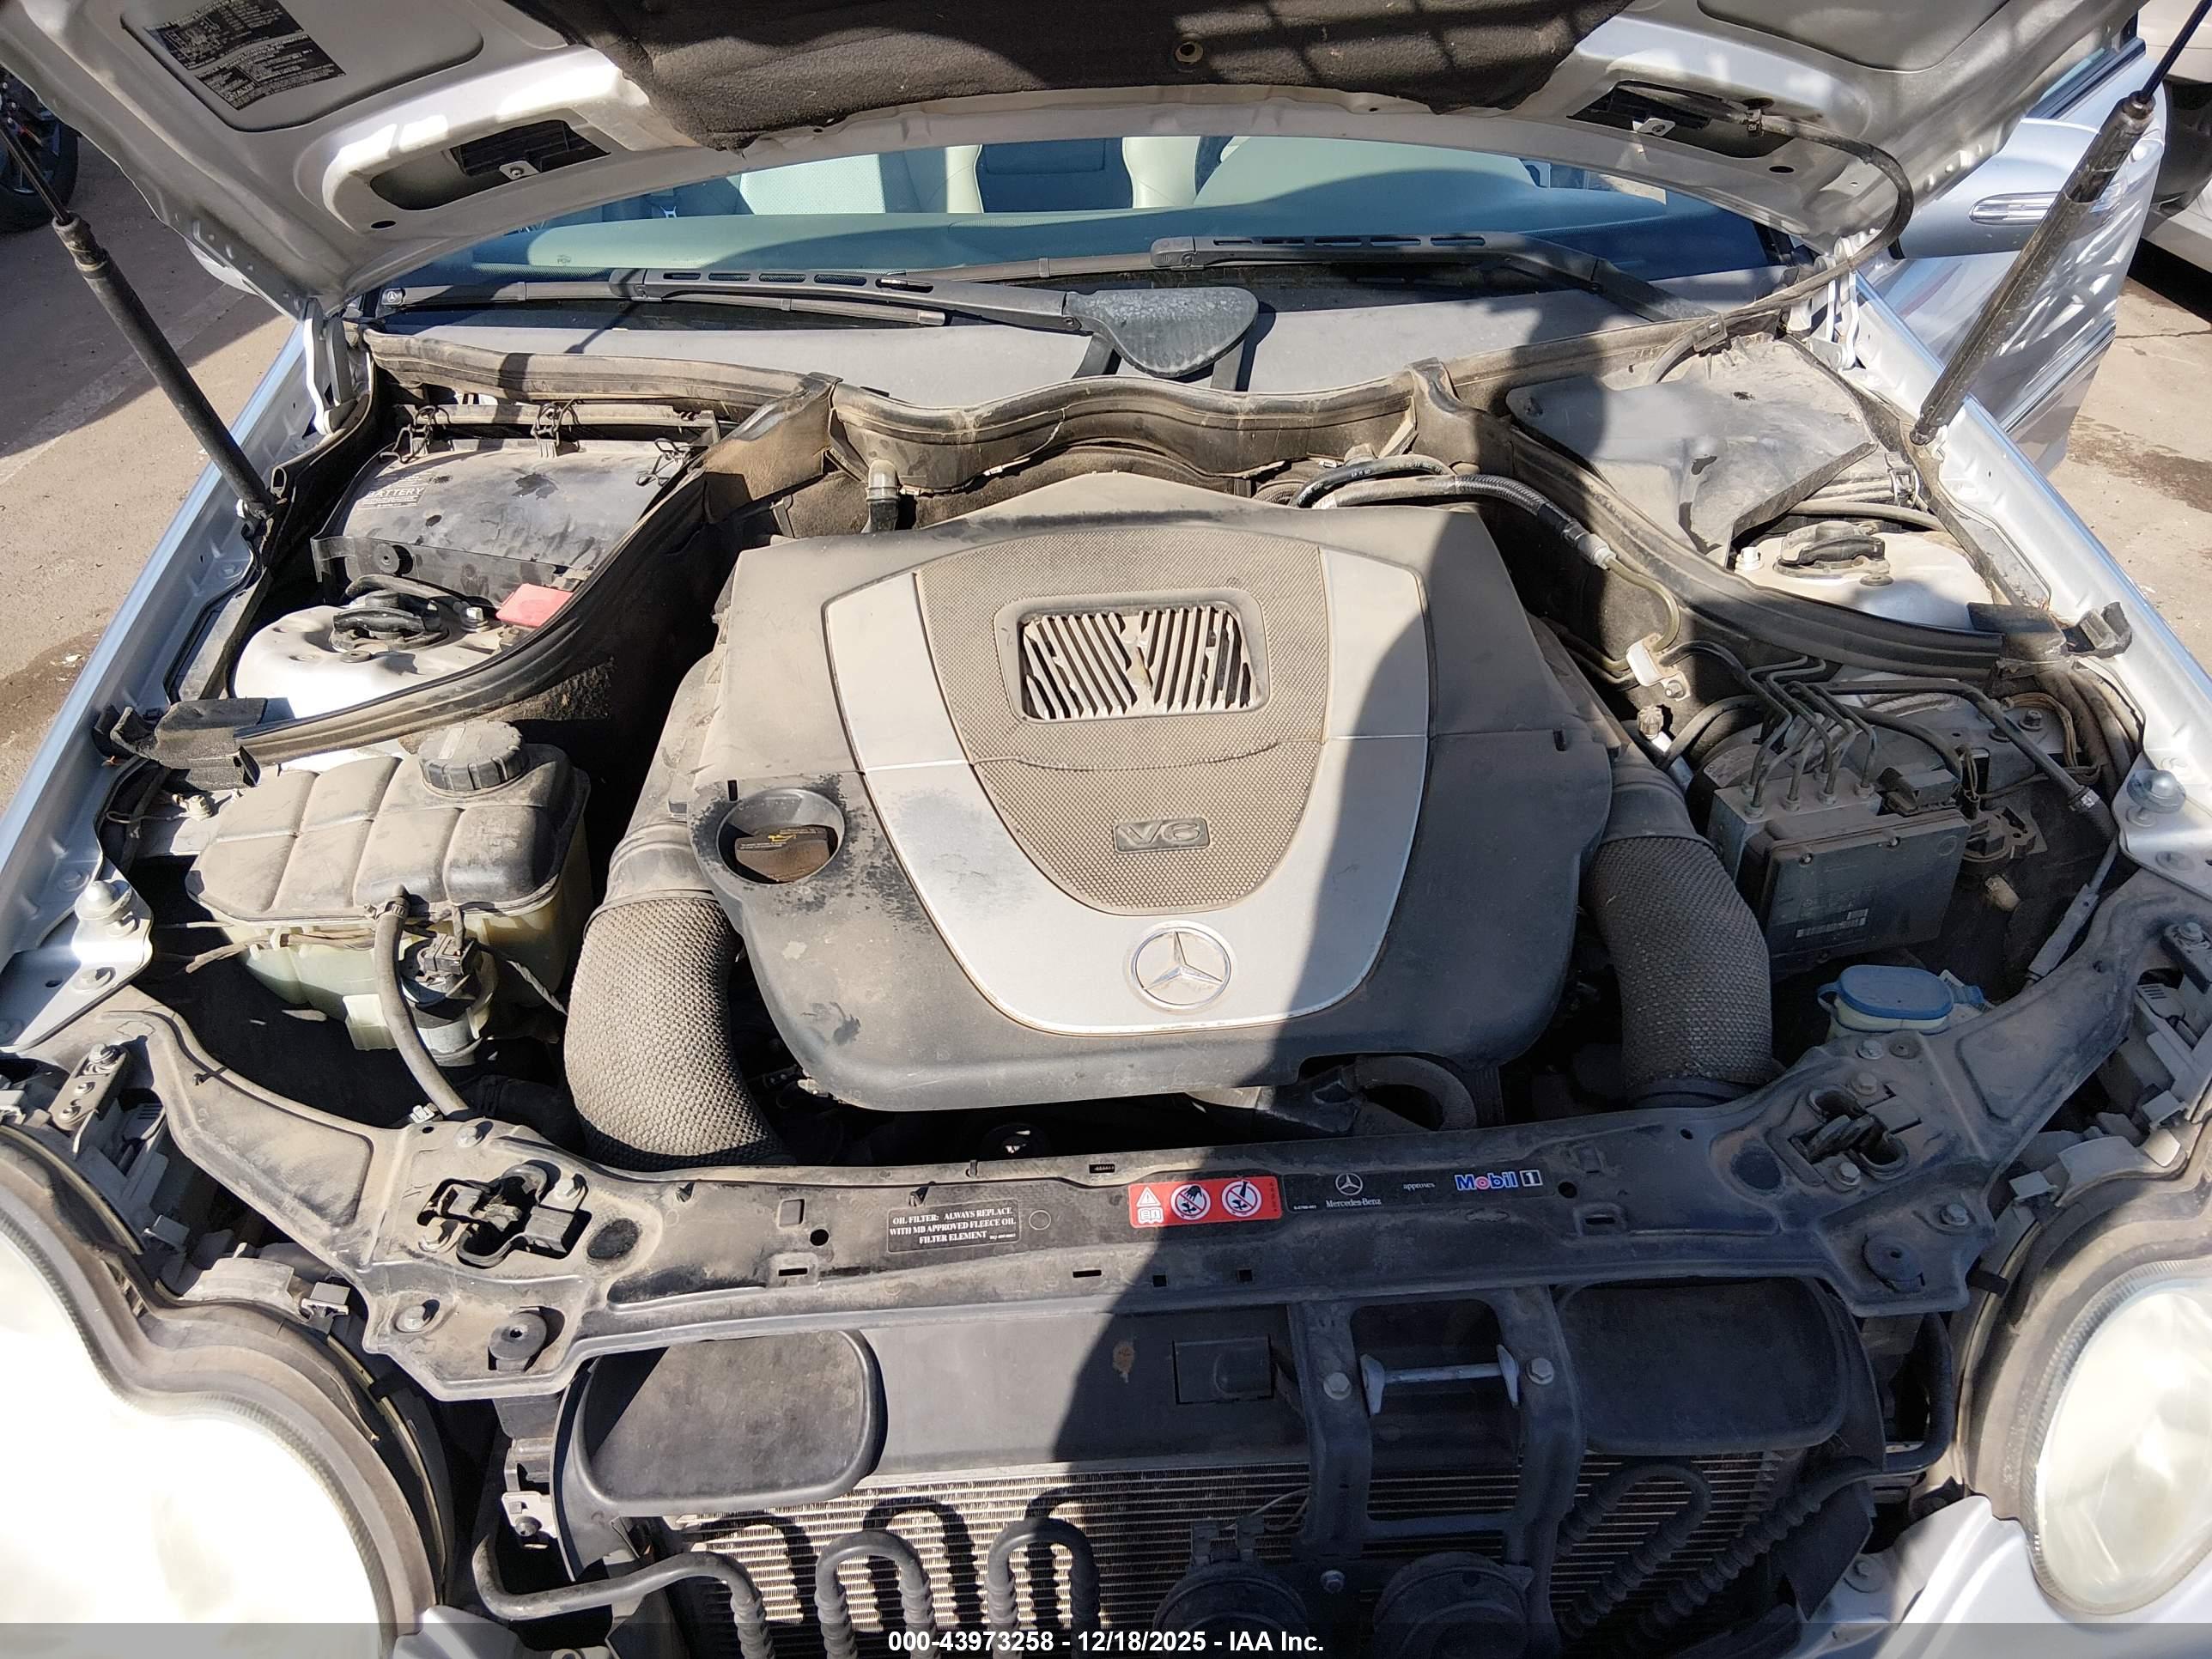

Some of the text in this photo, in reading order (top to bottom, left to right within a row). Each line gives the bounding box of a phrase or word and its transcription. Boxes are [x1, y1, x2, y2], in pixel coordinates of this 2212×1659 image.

[1118, 822, 1201, 847] V6
[1402, 1181, 1436, 1192] approves
[1455, 1171, 1519, 1191] Mobil
[1325, 1197, 1382, 1208] Mercedes-Benz
[908, 1214, 940, 1224] FILTER:
[944, 1210, 975, 1220] ALWAYS
[976, 1207, 1012, 1218] REPLACE
[890, 1227, 912, 1236] WITH
[926, 1222, 969, 1233] APPROVED
[969, 1219, 1000, 1231] FLEECE
[919, 1234, 948, 1244] FILTER
[949, 1231, 988, 1242] ELEMENT
